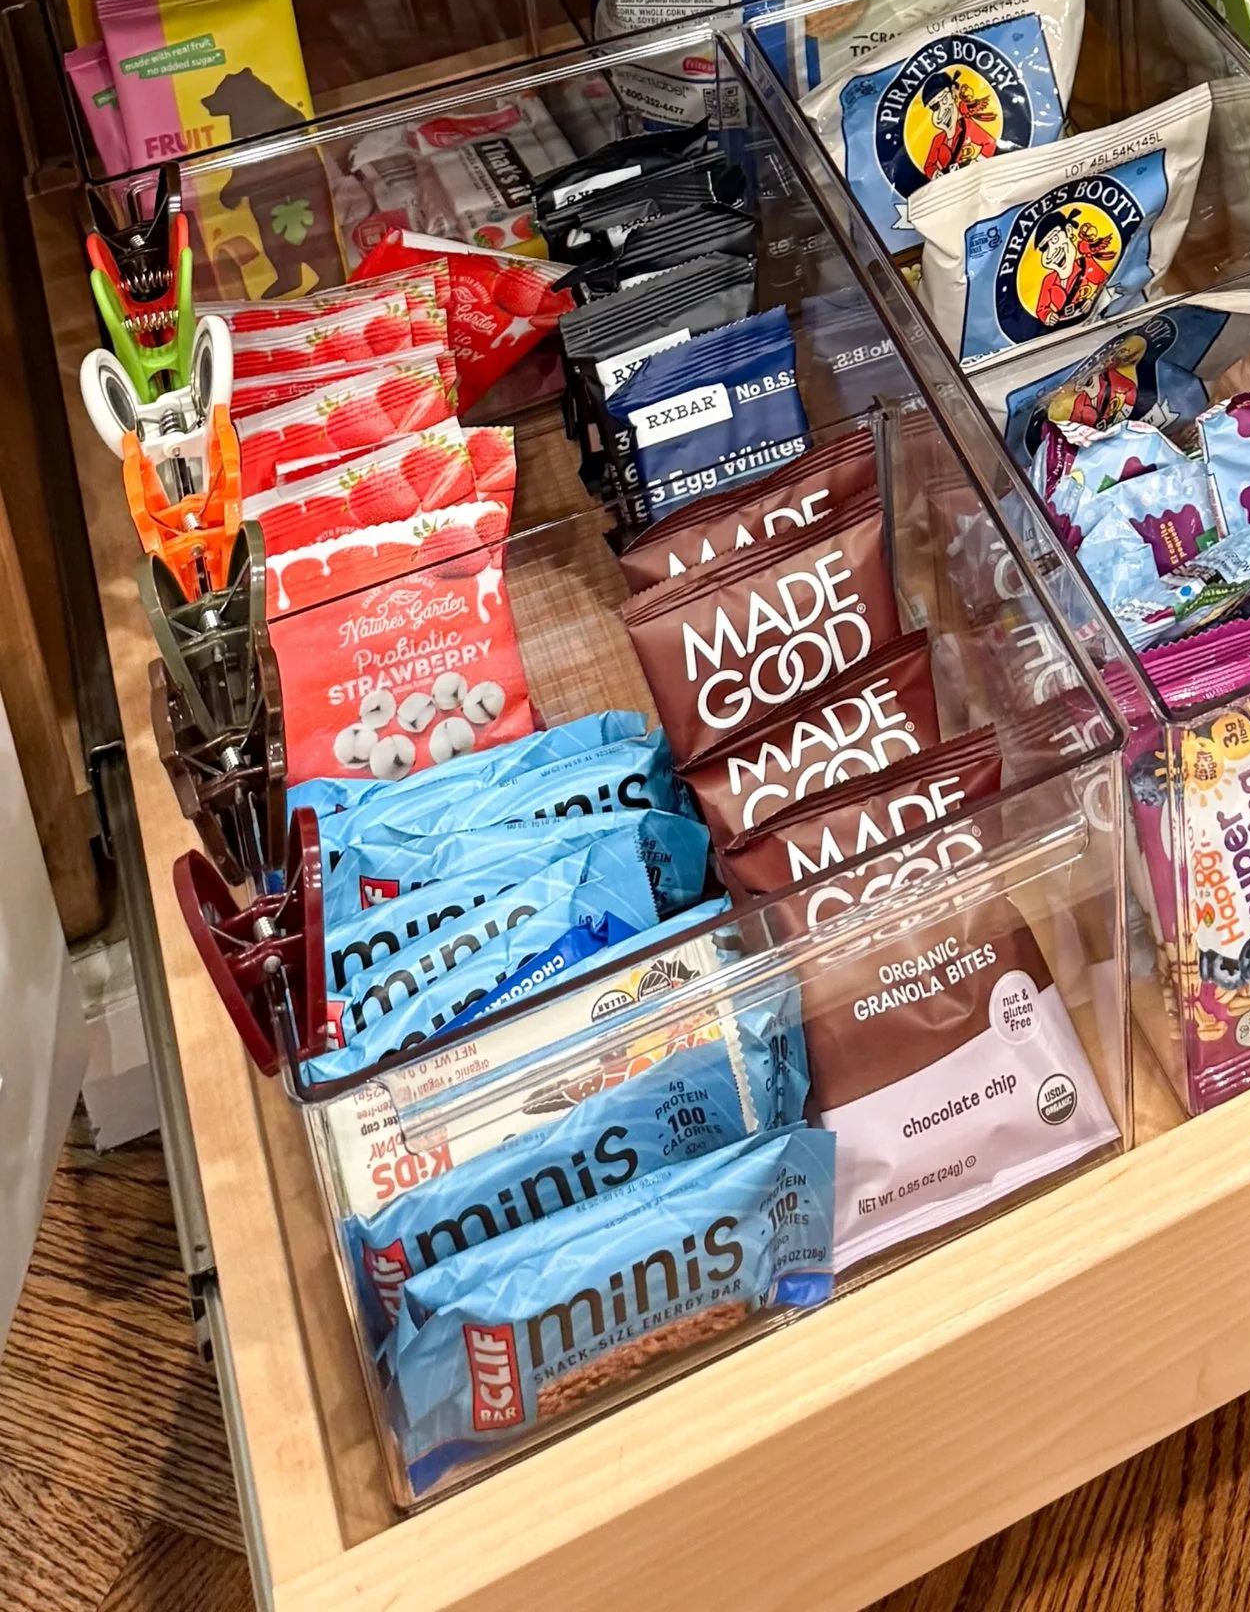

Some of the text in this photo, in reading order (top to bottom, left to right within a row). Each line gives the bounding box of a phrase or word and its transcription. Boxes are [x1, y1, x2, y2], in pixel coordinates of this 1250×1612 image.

[125, 57, 149, 71] made
[151, 50, 171, 65] with
[172, 44, 189, 60] real
[160, 58, 190, 73] added
[880, 40, 1021, 124] PIRATE'S BOOTY
[144, 125, 215, 159] FRUIT
[481, 141, 523, 185] That's
[1065, 163, 1085, 179] LOT
[1001, 180, 1140, 273] PIRATE'S BOOTY
[645, 389, 716, 430] RXBAR
[736, 382, 761, 400] No
[673, 438, 805, 496] Egg Whites
[406, 591, 469, 629] Garden
[682, 550, 858, 682] MADE
[327, 638, 492, 706] STRAWBERRY
[354, 629, 462, 674] Probiotic
[698, 611, 871, 729] GOOD
[727, 678, 907, 795] MADE
[1222, 721, 1240, 749] 3g
[853, 943, 997, 1021] GRANOLA BITES
[878, 937, 960, 986] ORGANIC
[1002, 988, 1030, 1008] nut &
[1003, 1002, 1033, 1023] gluten
[1009, 1016, 1032, 1032] free
[654, 1088, 709, 1119] PROTEIN
[903, 1072, 1017, 1139] chocolate chip
[1044, 1083, 1067, 1103] USDA
[360, 1119, 378, 1137] cup
[662, 1122, 722, 1156] CALORIES
[667, 1106, 705, 1132] 100
[414, 1125, 640, 1268] minis
[858, 1159, 964, 1216] NET 0.85 OZ (24g)
[527, 1215, 744, 1369] minis
[643, 1295, 704, 1329] ENERGY
[712, 1279, 741, 1300] BAR
[471, 1328, 512, 1409] CLIF
[479, 1405, 517, 1422] BAR
